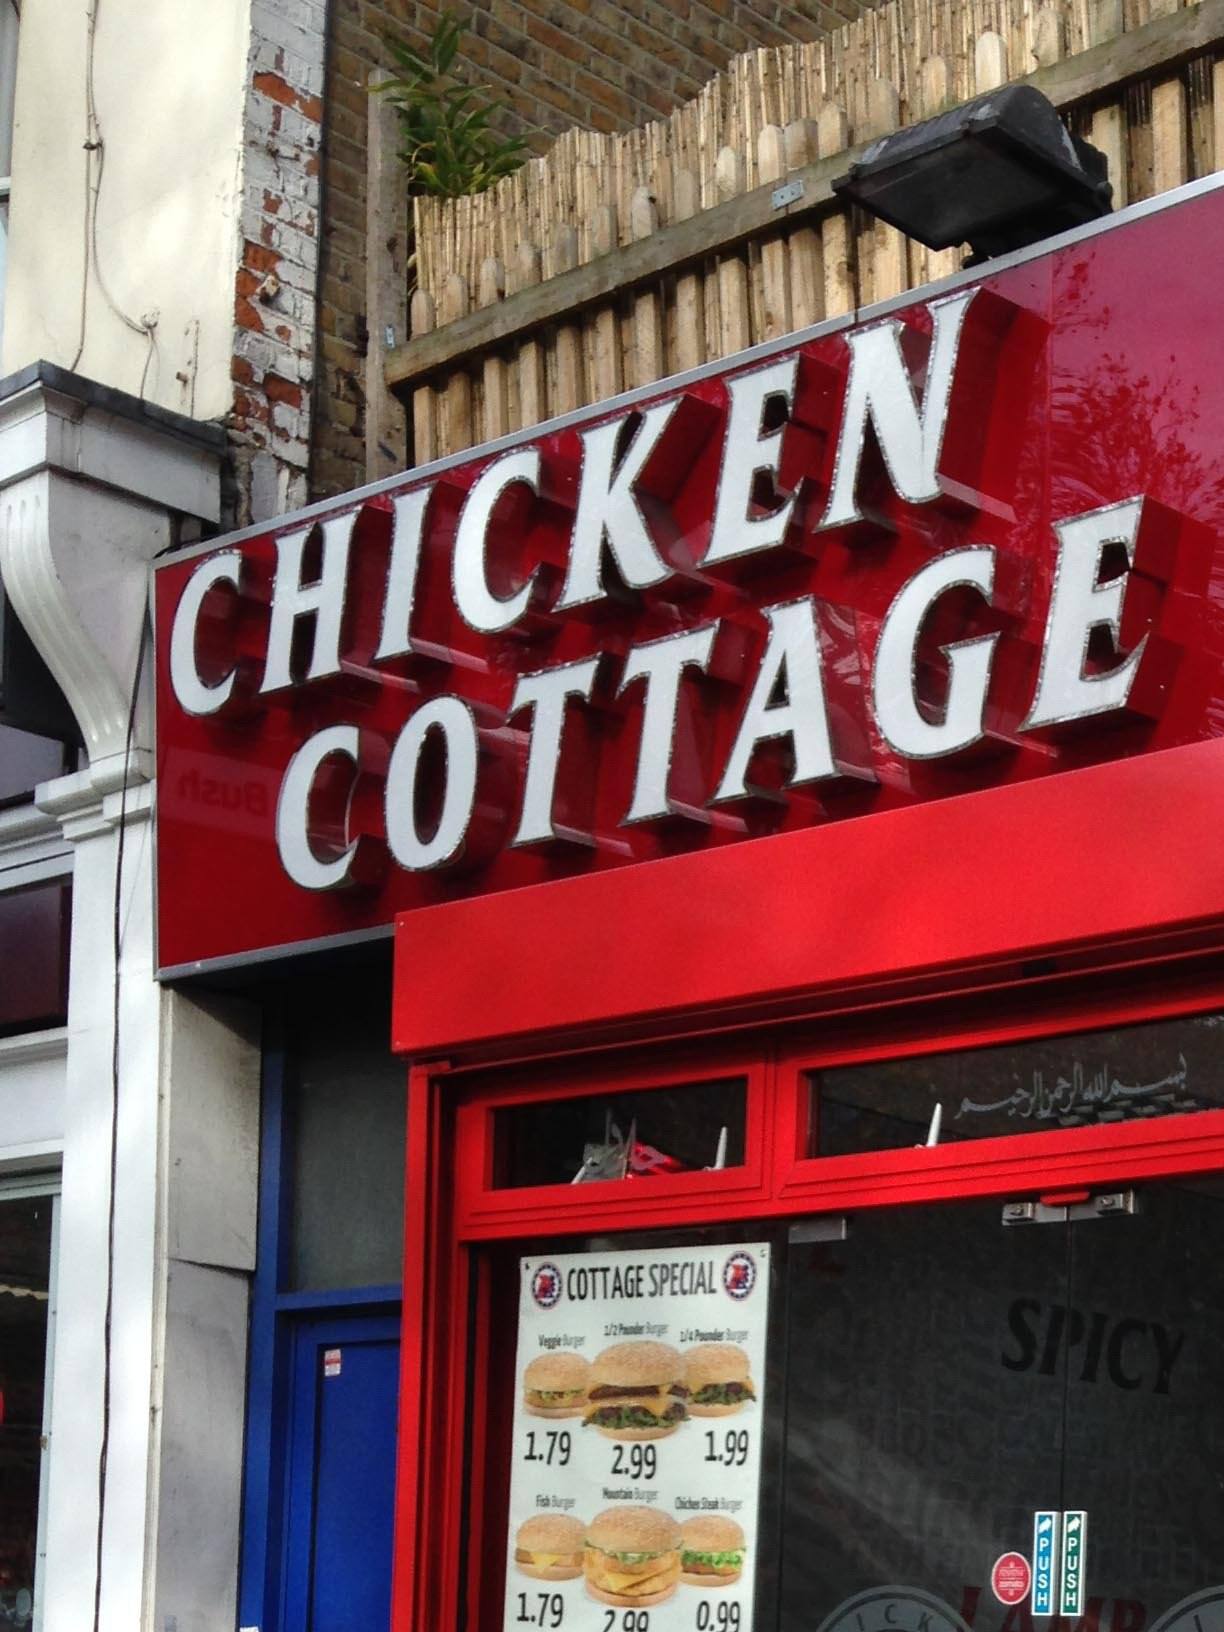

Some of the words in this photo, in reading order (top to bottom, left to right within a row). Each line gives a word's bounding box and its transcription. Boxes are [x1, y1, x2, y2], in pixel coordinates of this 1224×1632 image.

[169, 285, 983, 718] CHICKEN
[276, 494, 1150, 892] COTTAGE
[567, 1265, 644, 1300] COTTAGE
[649, 1261, 717, 1297] SPECIAL
[1002, 1299, 1185, 1394] SPICY
[524, 1431, 571, 1466] 1.79
[611, 1444, 657, 1479] 2.99
[704, 1430, 749, 1466] 1.99
[1037, 1538, 1050, 1606] PUSH
[1066, 1538, 1078, 1606] PUSH
[517, 1592, 564, 1628] 1.79
